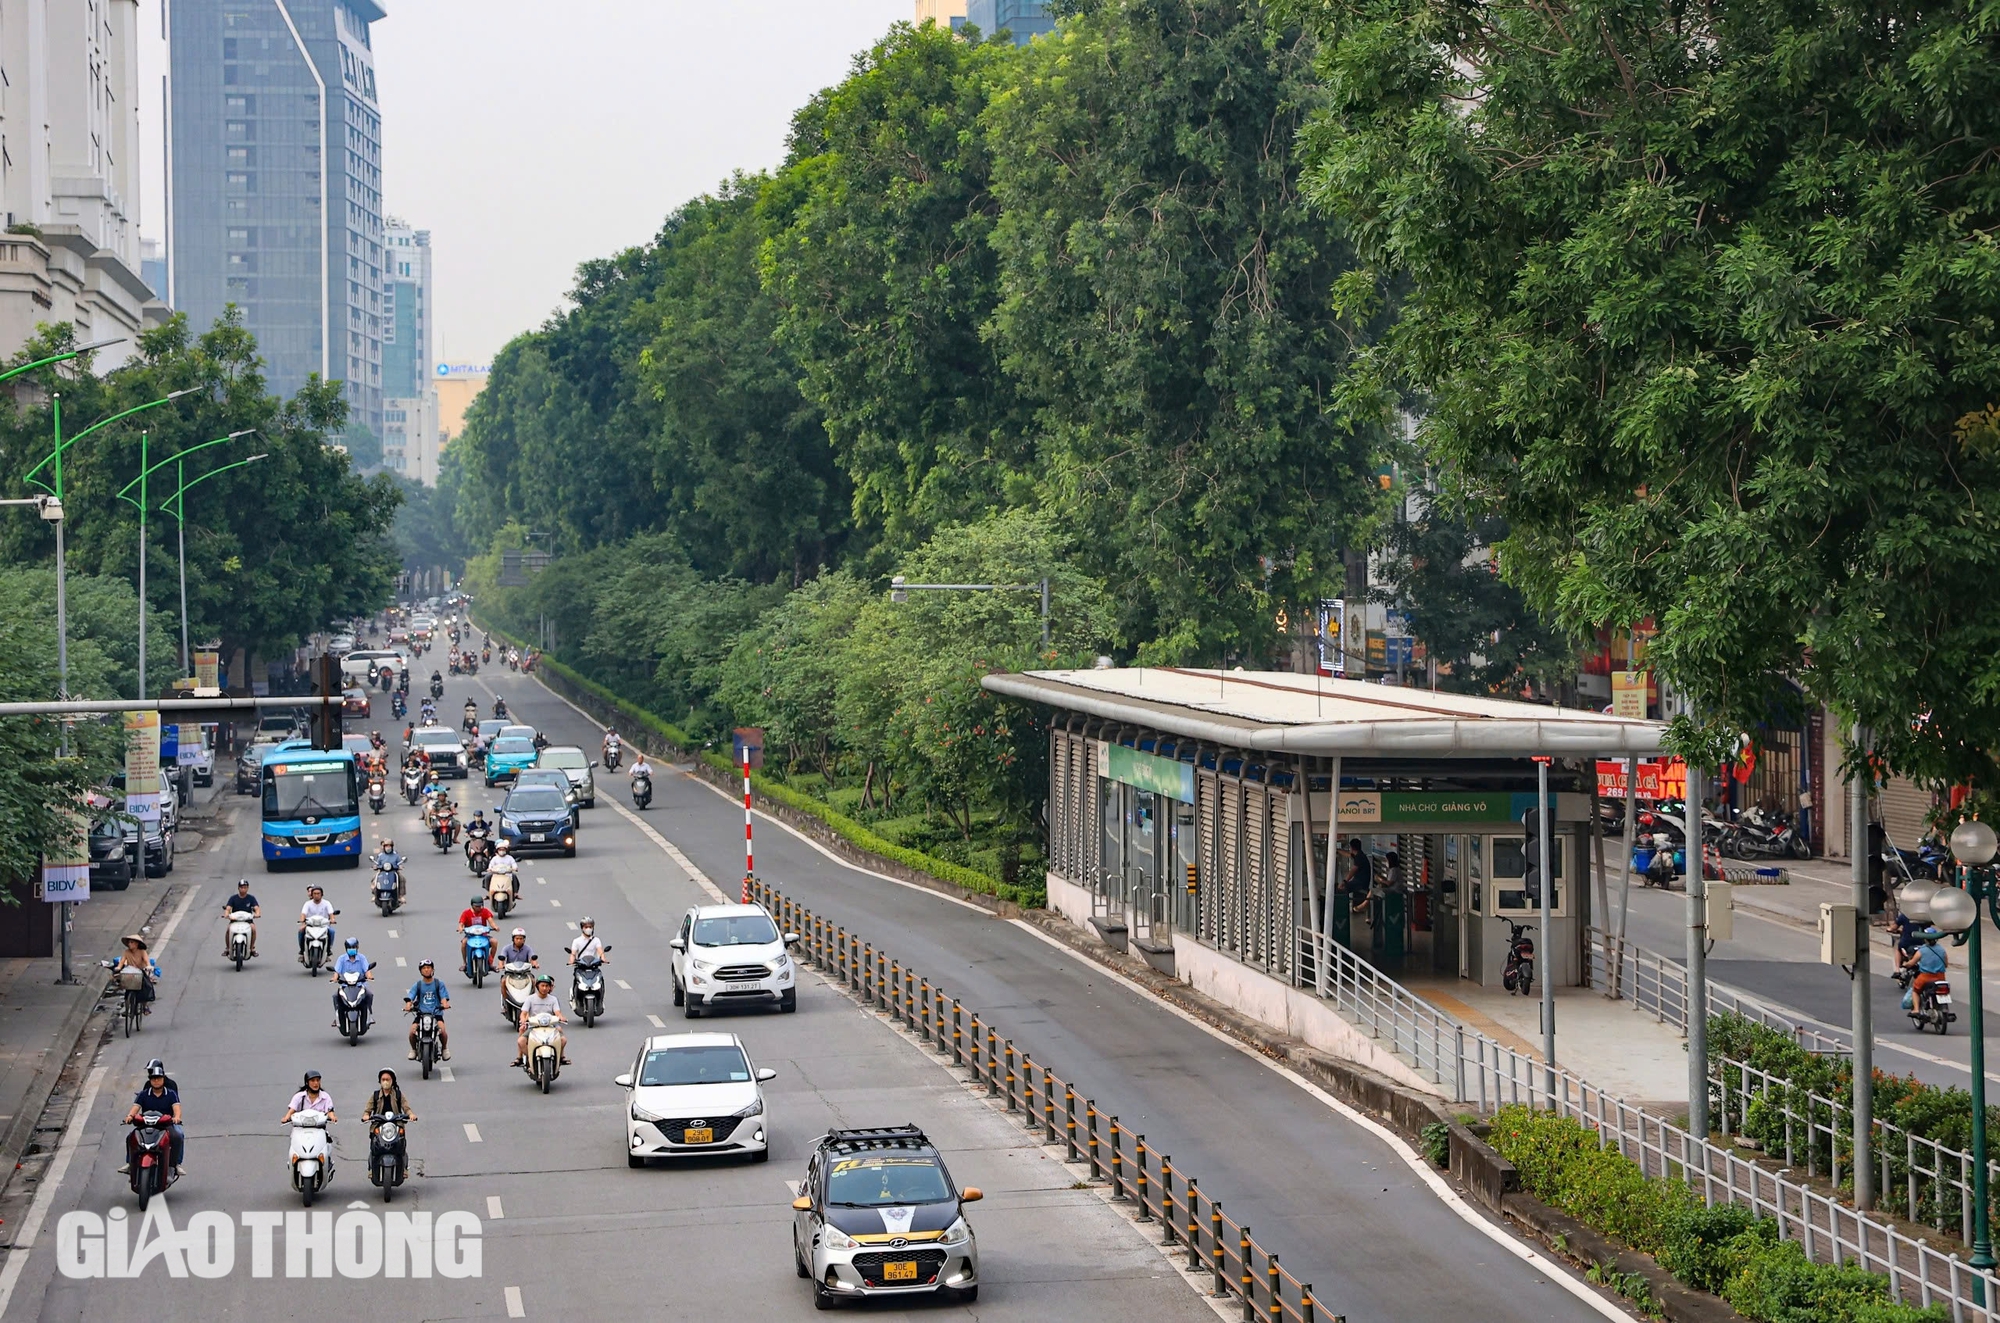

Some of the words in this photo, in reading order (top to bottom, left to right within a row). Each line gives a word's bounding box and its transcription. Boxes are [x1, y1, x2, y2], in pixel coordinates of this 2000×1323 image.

[179, 750, 197, 760] BIDV
[1607, 788, 1623, 797] 269
[129, 803, 151, 814] BIDV
[1362, 807, 1376, 815] BRT
[1399, 802, 1417, 812] NHÀ
[1418, 802, 1438, 812] CHỜ
[1442, 801, 1471, 812] GIẢNG
[1473, 801, 1487, 812] VÕ
[47, 880, 76, 892] BIDV
[893, 1263, 908, 1271] 30E
[887, 1270, 914, 1279] 961.47
